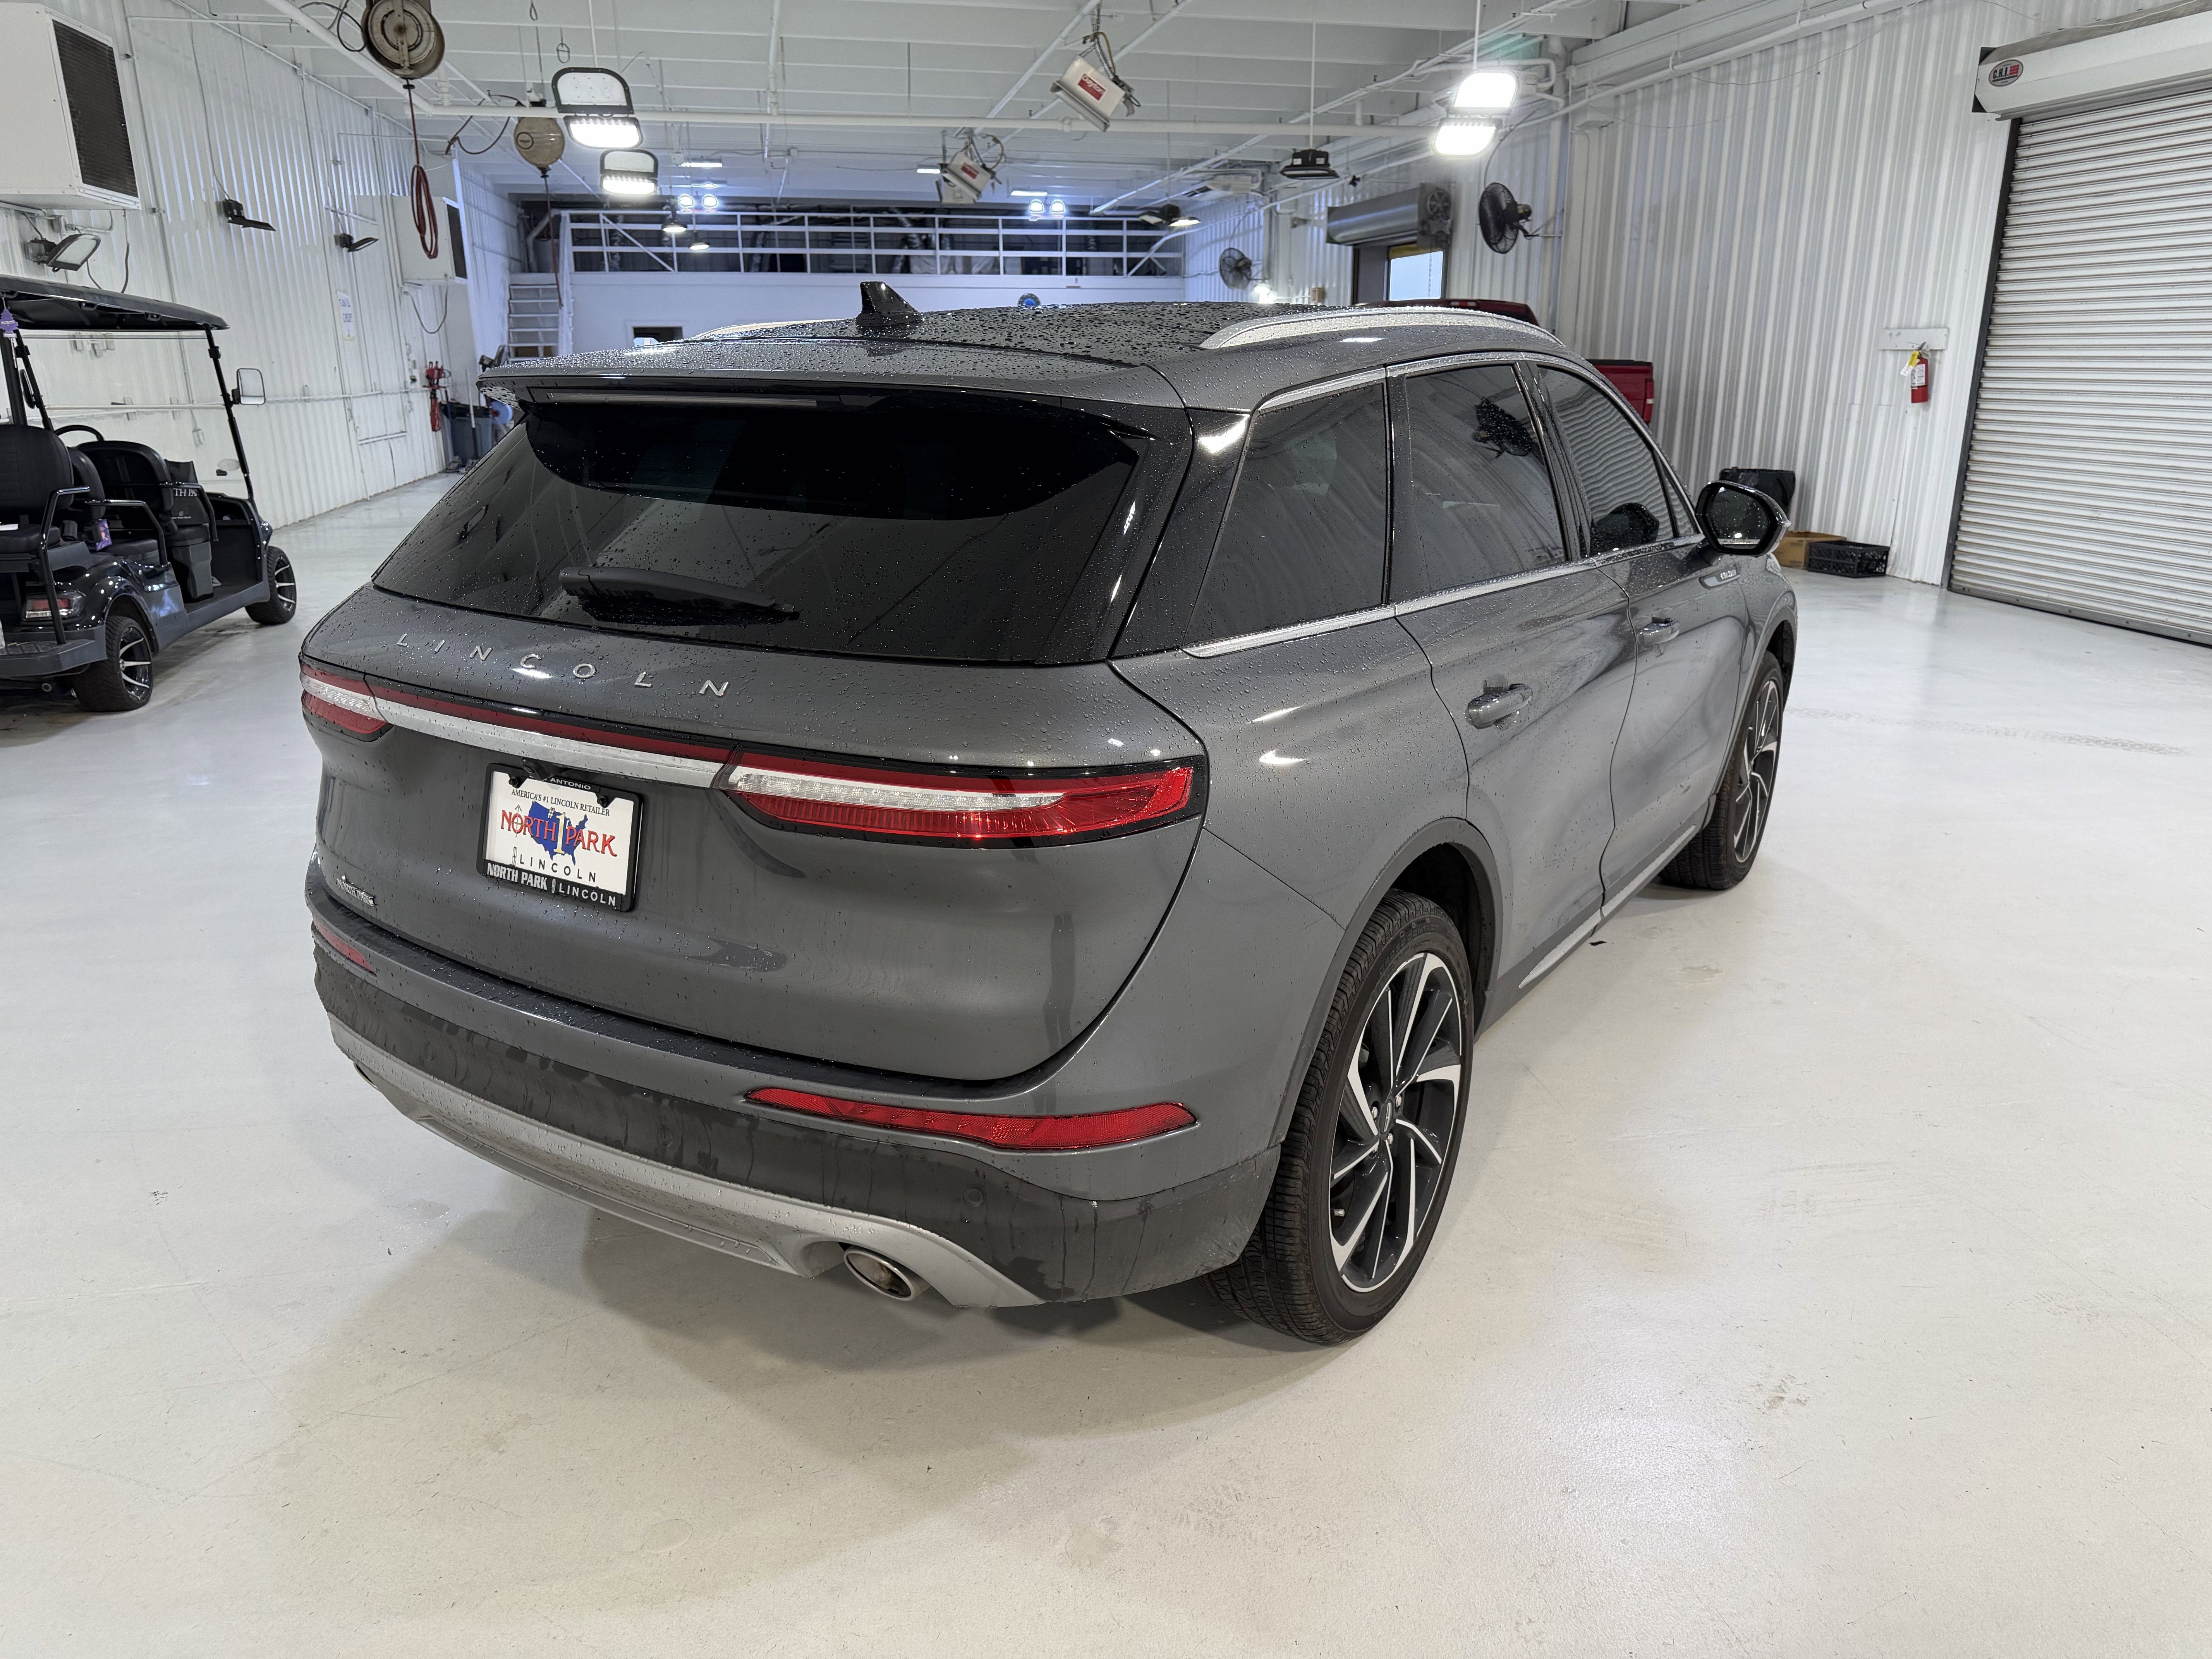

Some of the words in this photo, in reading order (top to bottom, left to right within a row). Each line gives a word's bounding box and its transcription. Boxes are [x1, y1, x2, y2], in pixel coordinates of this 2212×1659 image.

[1992, 67, 2009, 79] C.H.I.
[396, 633, 730, 697] LINCOLN
[550, 778, 591, 790] ANTONIO
[511, 788, 542, 801] AMERICA'S
[551, 797, 579, 810] LINCOLN
[580, 803, 610, 817] RETAILER
[500, 809, 557, 842] NORTH
[565, 825, 618, 857] PARK
[519, 854, 596, 883] LINCOLN
[487, 862, 519, 882] NORTH
[521, 871, 547, 890] PARK
[558, 883, 616, 906] LINCOLN
